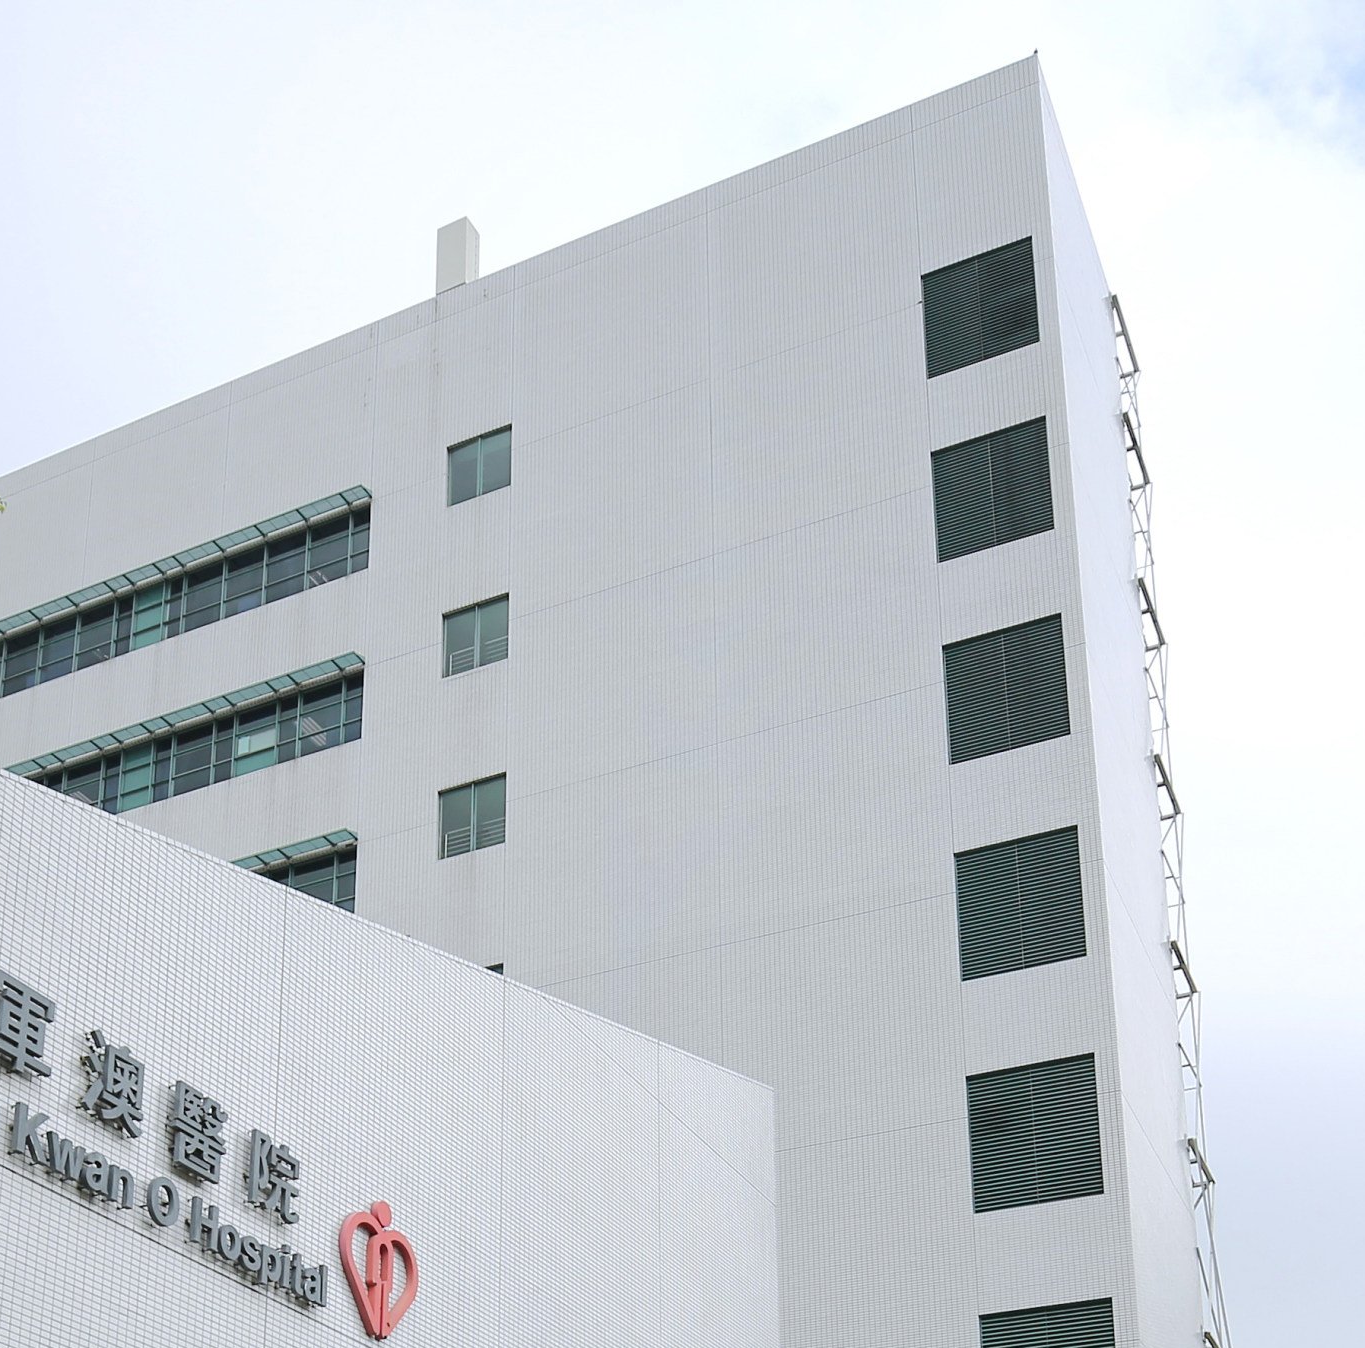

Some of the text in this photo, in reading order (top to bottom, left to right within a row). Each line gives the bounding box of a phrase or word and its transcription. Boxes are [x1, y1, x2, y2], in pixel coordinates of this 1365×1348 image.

[9, 1102, 135, 1210] Kwan
[146, 1176, 180, 1228] O
[187, 1196, 329, 1308] Hospital
